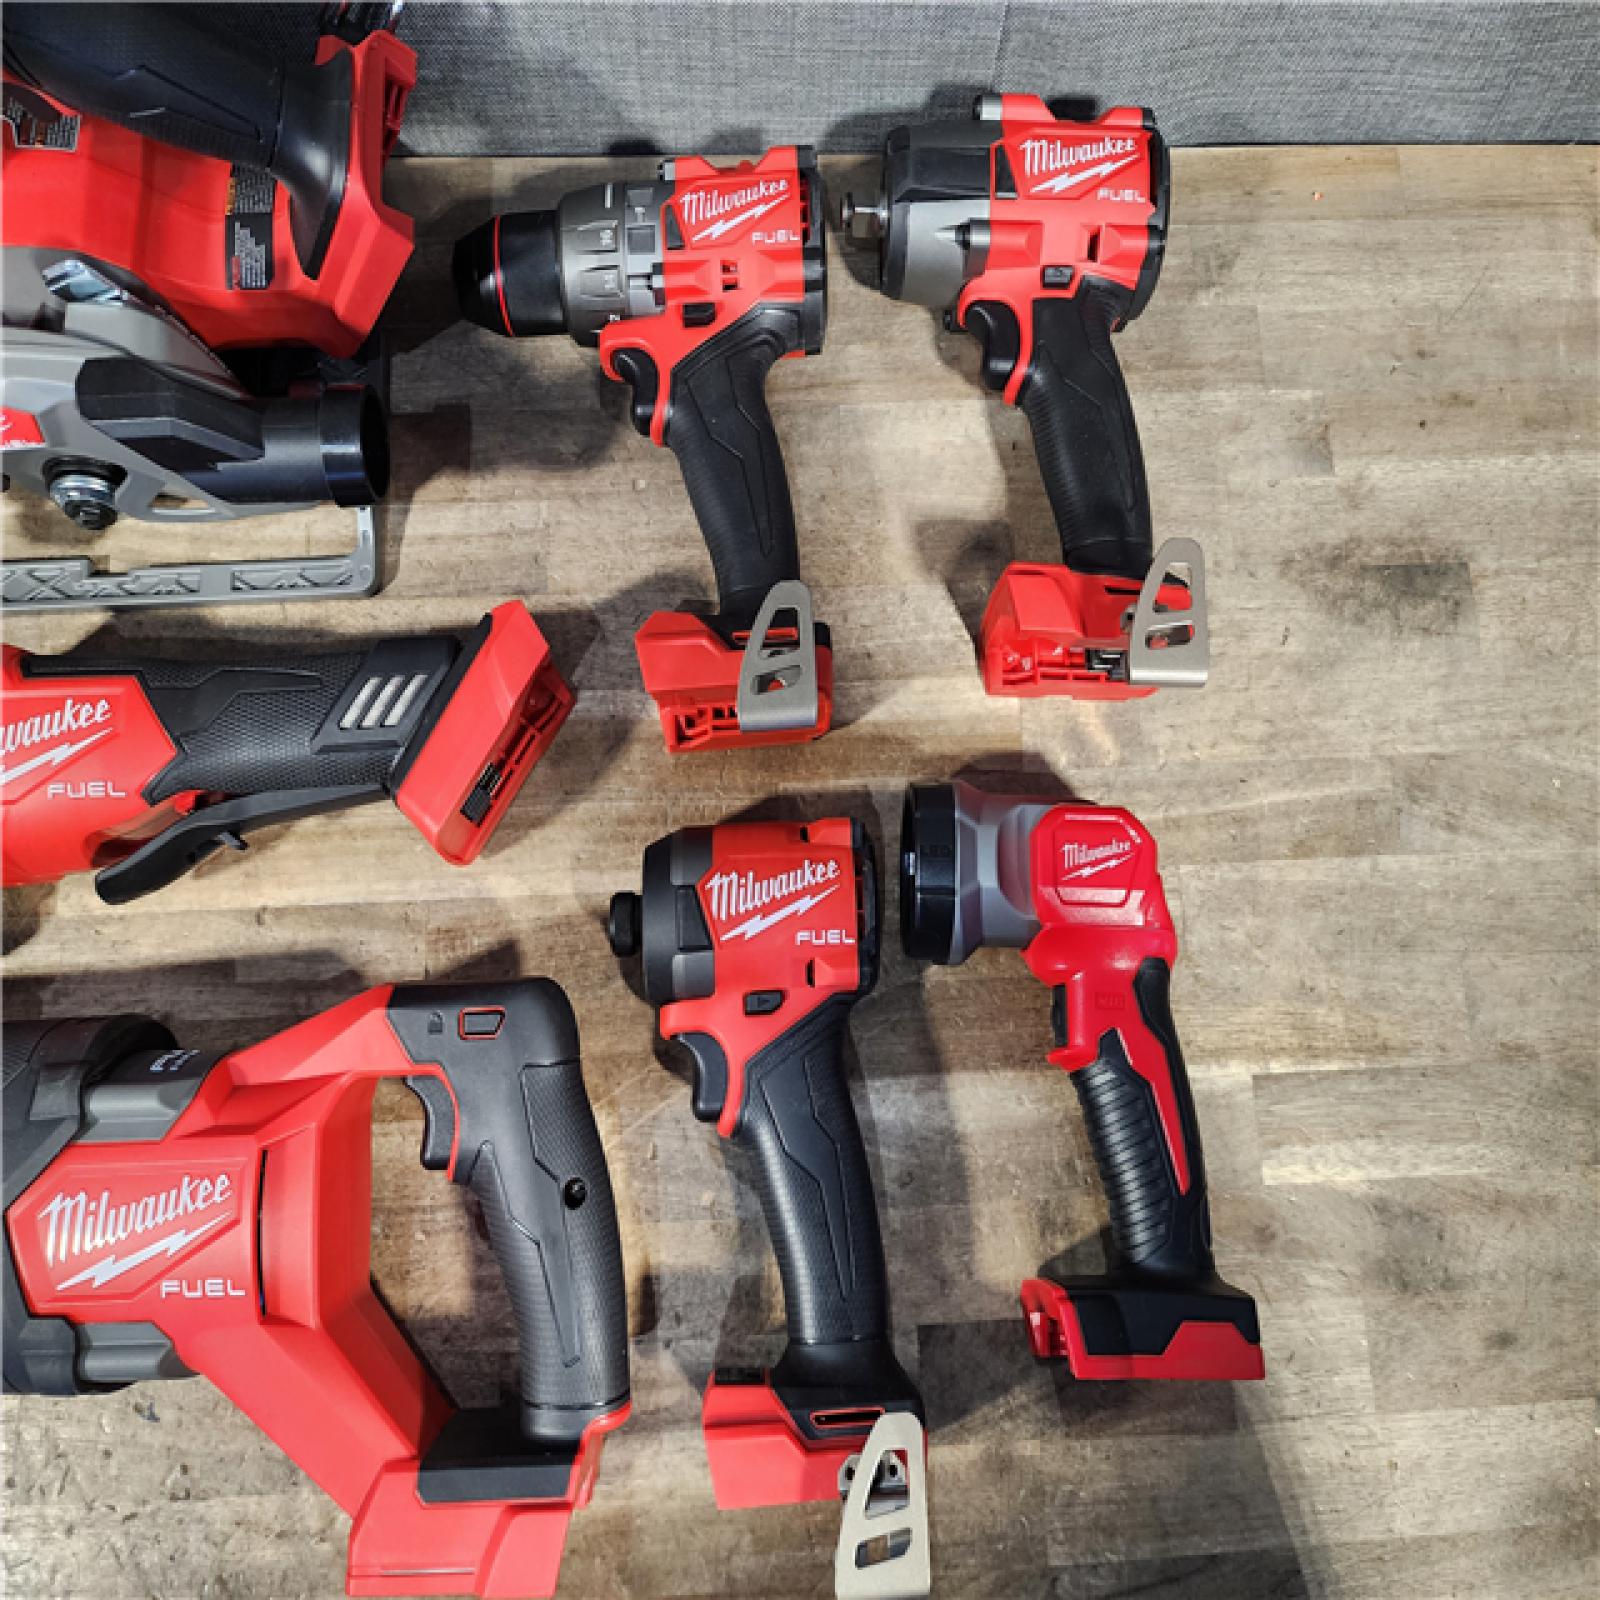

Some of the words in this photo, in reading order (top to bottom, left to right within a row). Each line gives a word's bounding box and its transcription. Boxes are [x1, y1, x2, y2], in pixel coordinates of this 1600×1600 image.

[1020, 136, 1135, 178] Milwaukee
[680, 179, 789, 225] Milwaukee
[1097, 188, 1146, 203] FUEL
[751, 230, 800, 245] FUEL
[47, 780, 126, 799] FUEL
[1060, 837, 1133, 870] Milwaukee
[705, 859, 840, 921] Milwaukee
[795, 929, 856, 946] FUEL
[37, 1174, 233, 1268] Milwaukee
[160, 1278, 246, 1299] FUEL
